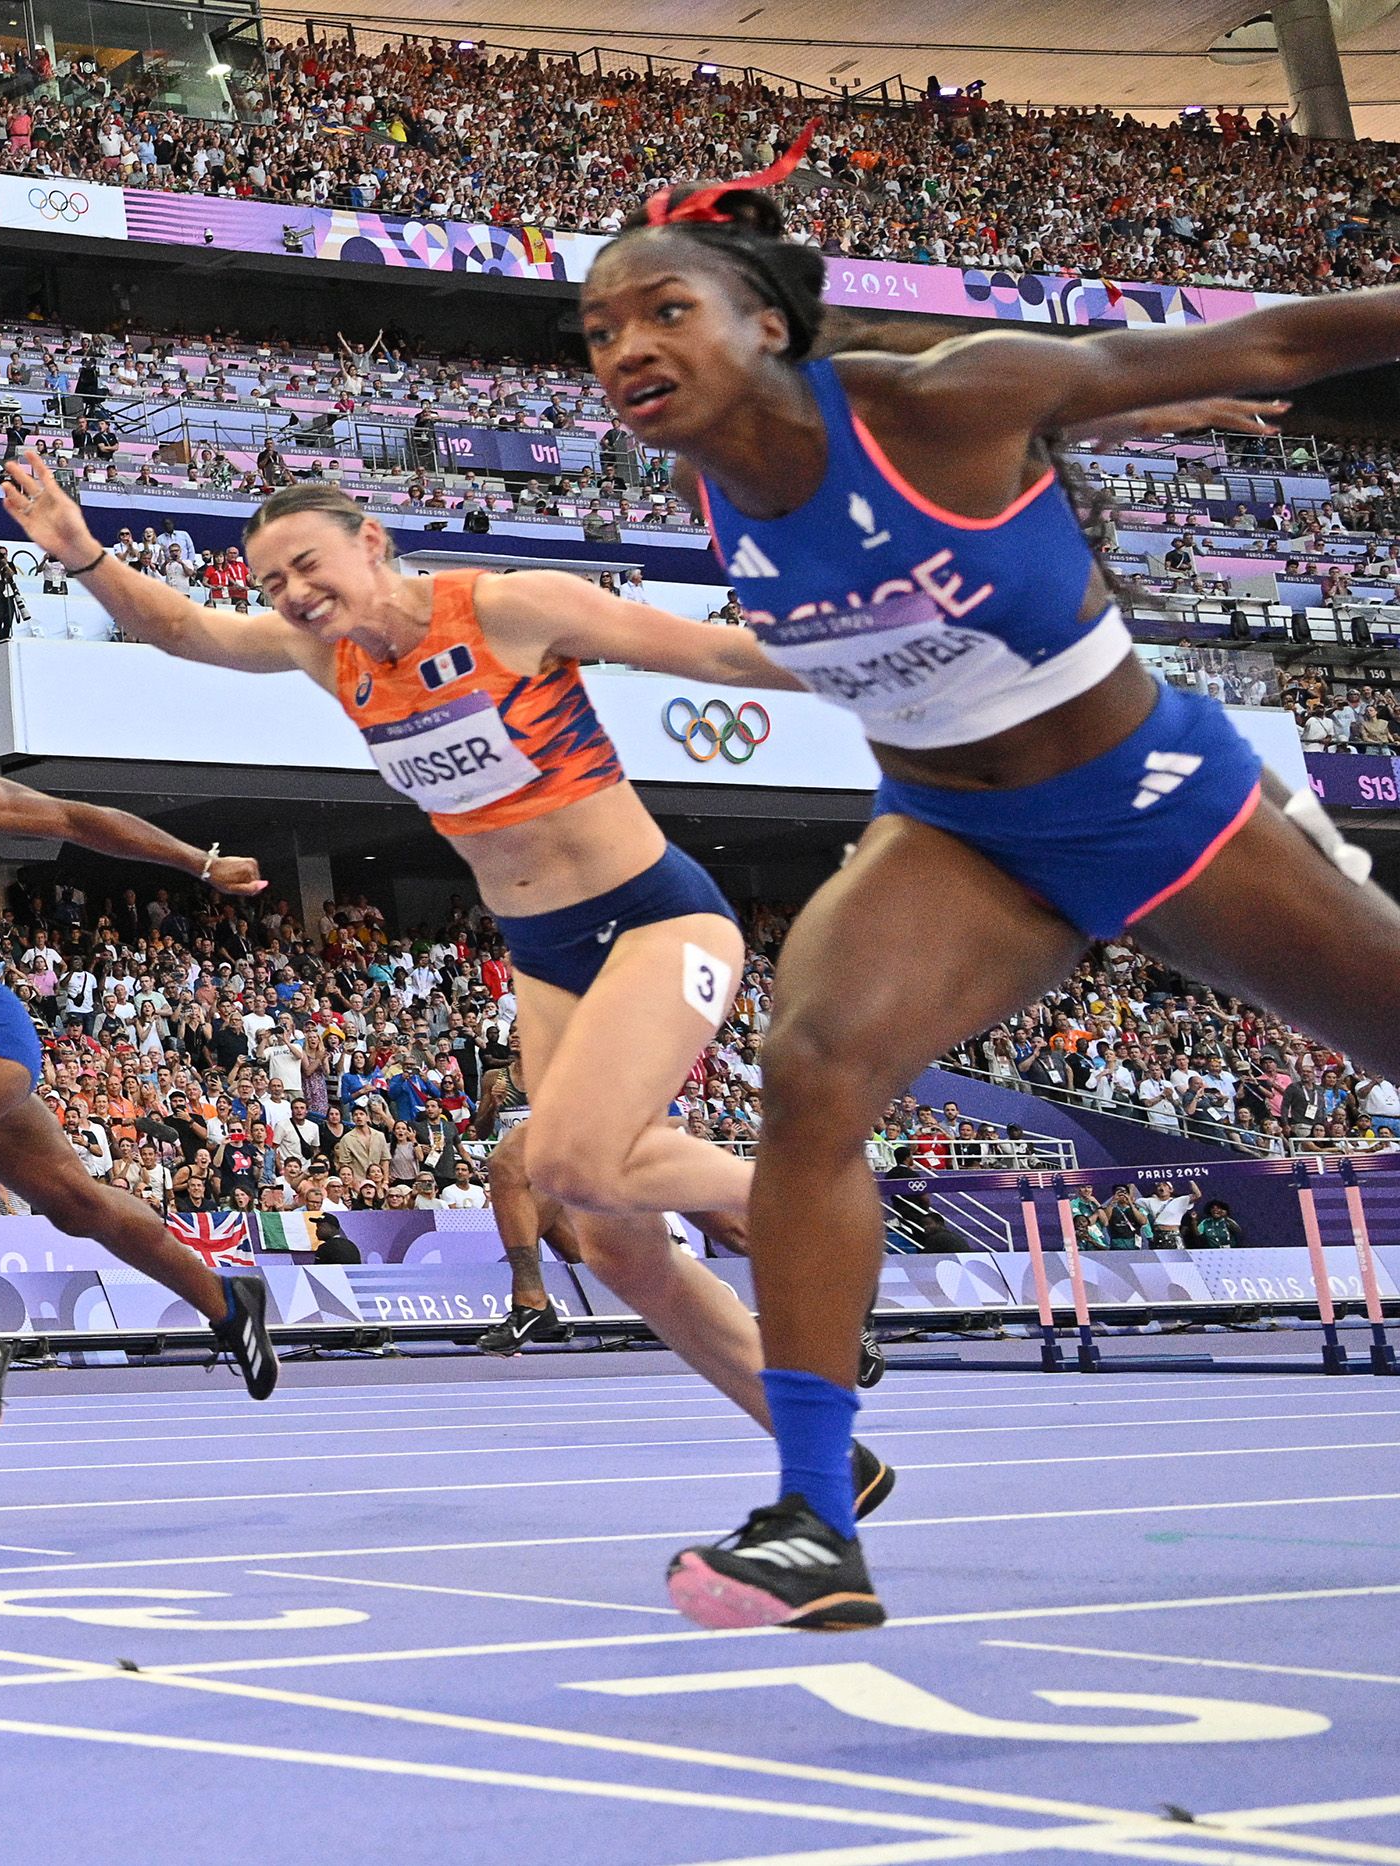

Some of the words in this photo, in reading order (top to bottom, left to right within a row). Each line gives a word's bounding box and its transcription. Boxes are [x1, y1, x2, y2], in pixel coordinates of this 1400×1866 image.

[842, 271, 919, 298] 2024
[530, 444, 560, 464] U11
[1369, 669, 1386, 679] 150
[1358, 775, 1397, 802] S13
[698, 965, 715, 1003] 3
[1176, 1167, 1209, 1178] 2024
[557, 1662, 1333, 1744] 2
